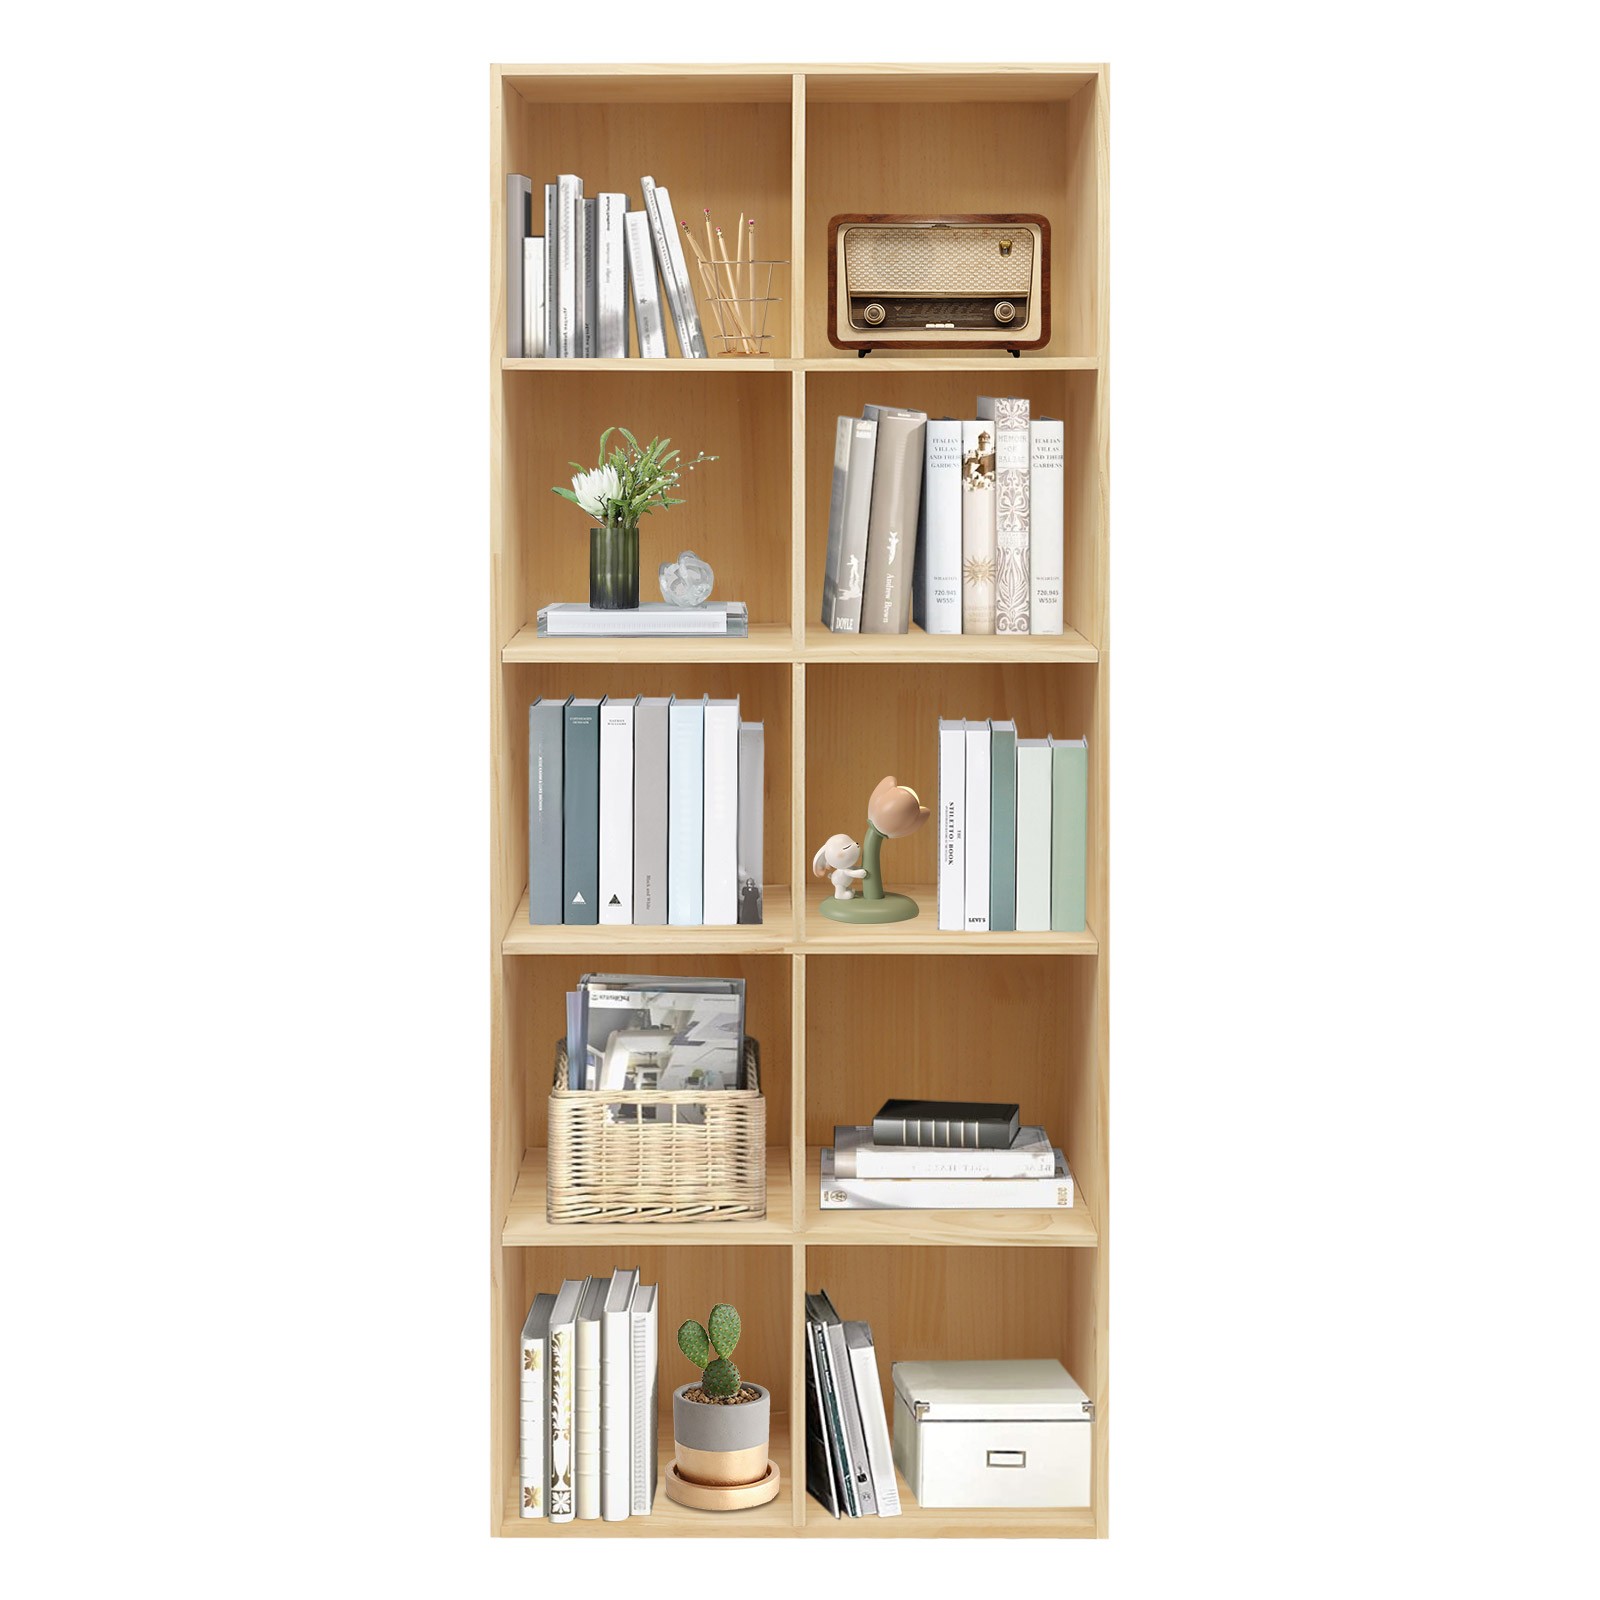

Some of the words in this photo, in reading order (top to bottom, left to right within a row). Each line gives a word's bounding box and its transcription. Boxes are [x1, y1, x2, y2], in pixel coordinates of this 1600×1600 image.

[884, 573, 895, 599] Andrew
[882, 601, 893, 623] Brown
[836, 617, 854, 630] DOYLE
